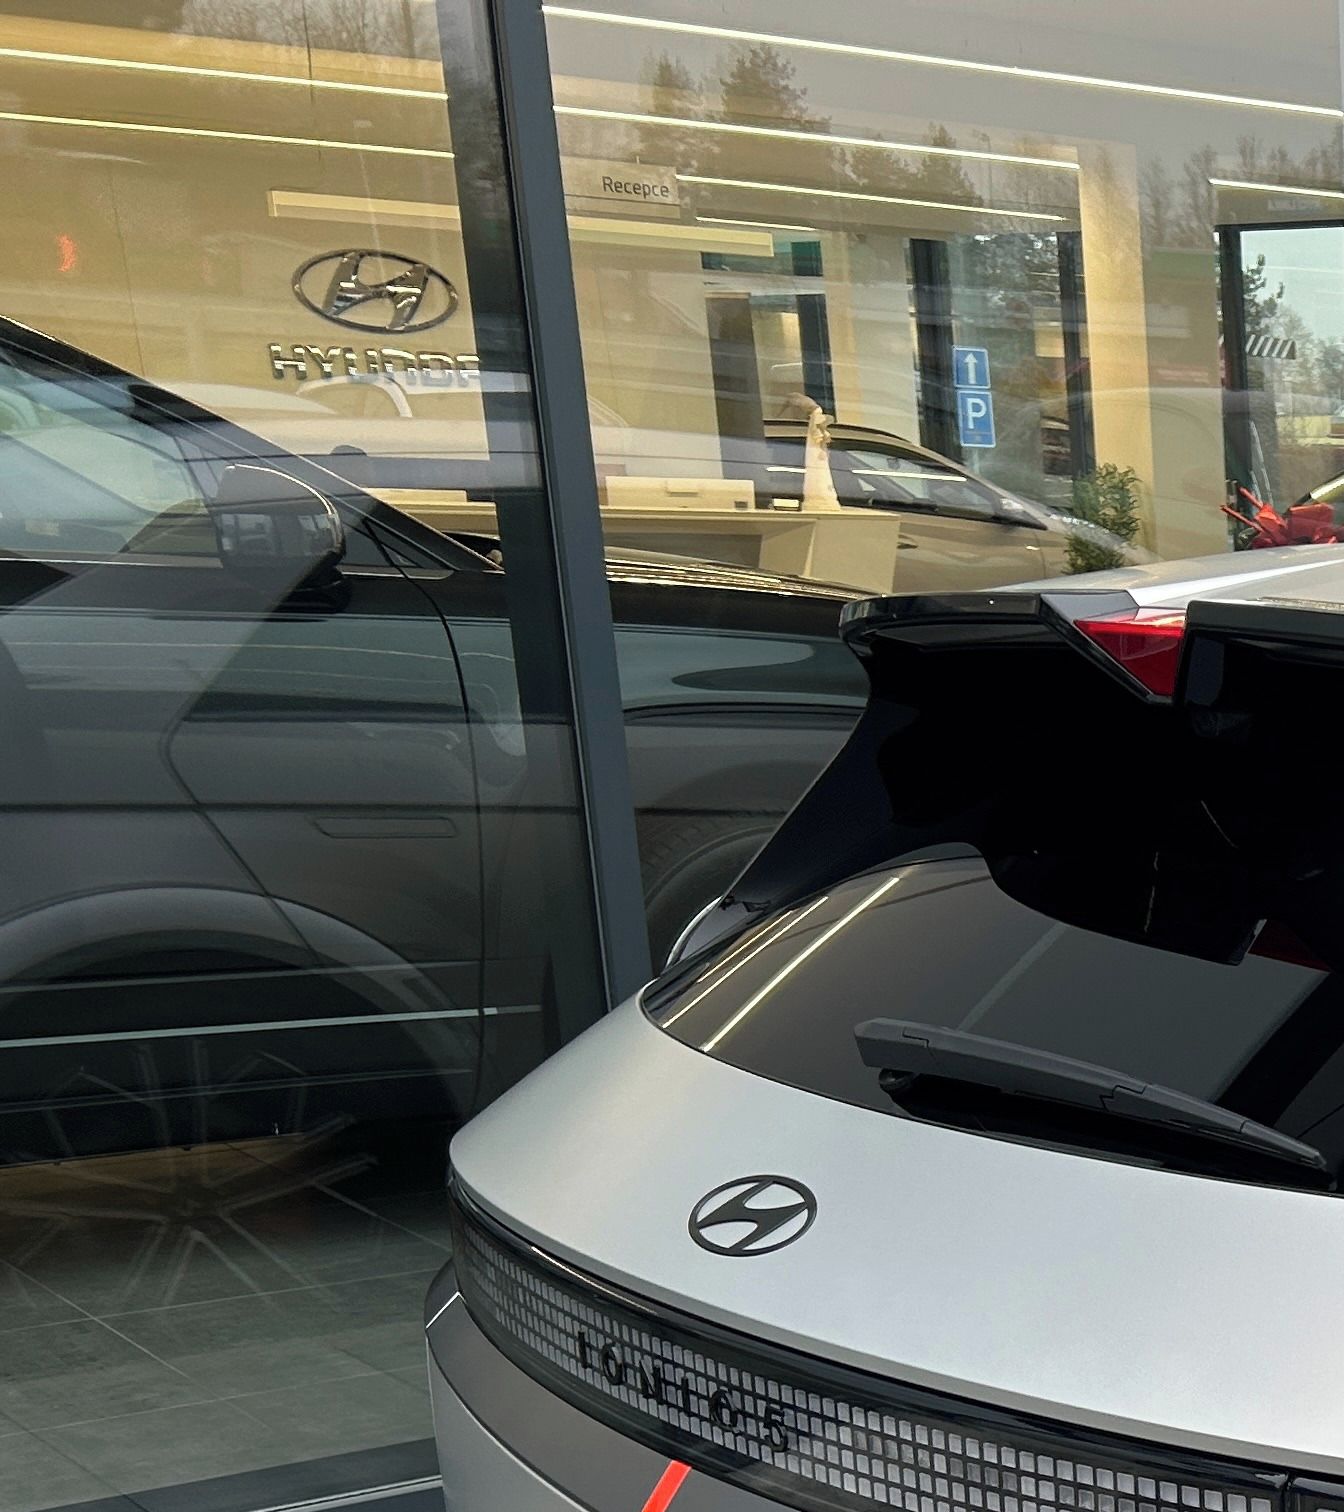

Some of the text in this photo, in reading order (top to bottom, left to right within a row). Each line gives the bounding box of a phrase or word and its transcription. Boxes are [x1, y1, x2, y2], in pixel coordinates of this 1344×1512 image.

[602, 175, 670, 199] Recepce
[267, 342, 480, 388] HYUNDA
[966, 397, 987, 430] P
[763, 1403, 790, 1453] 5
